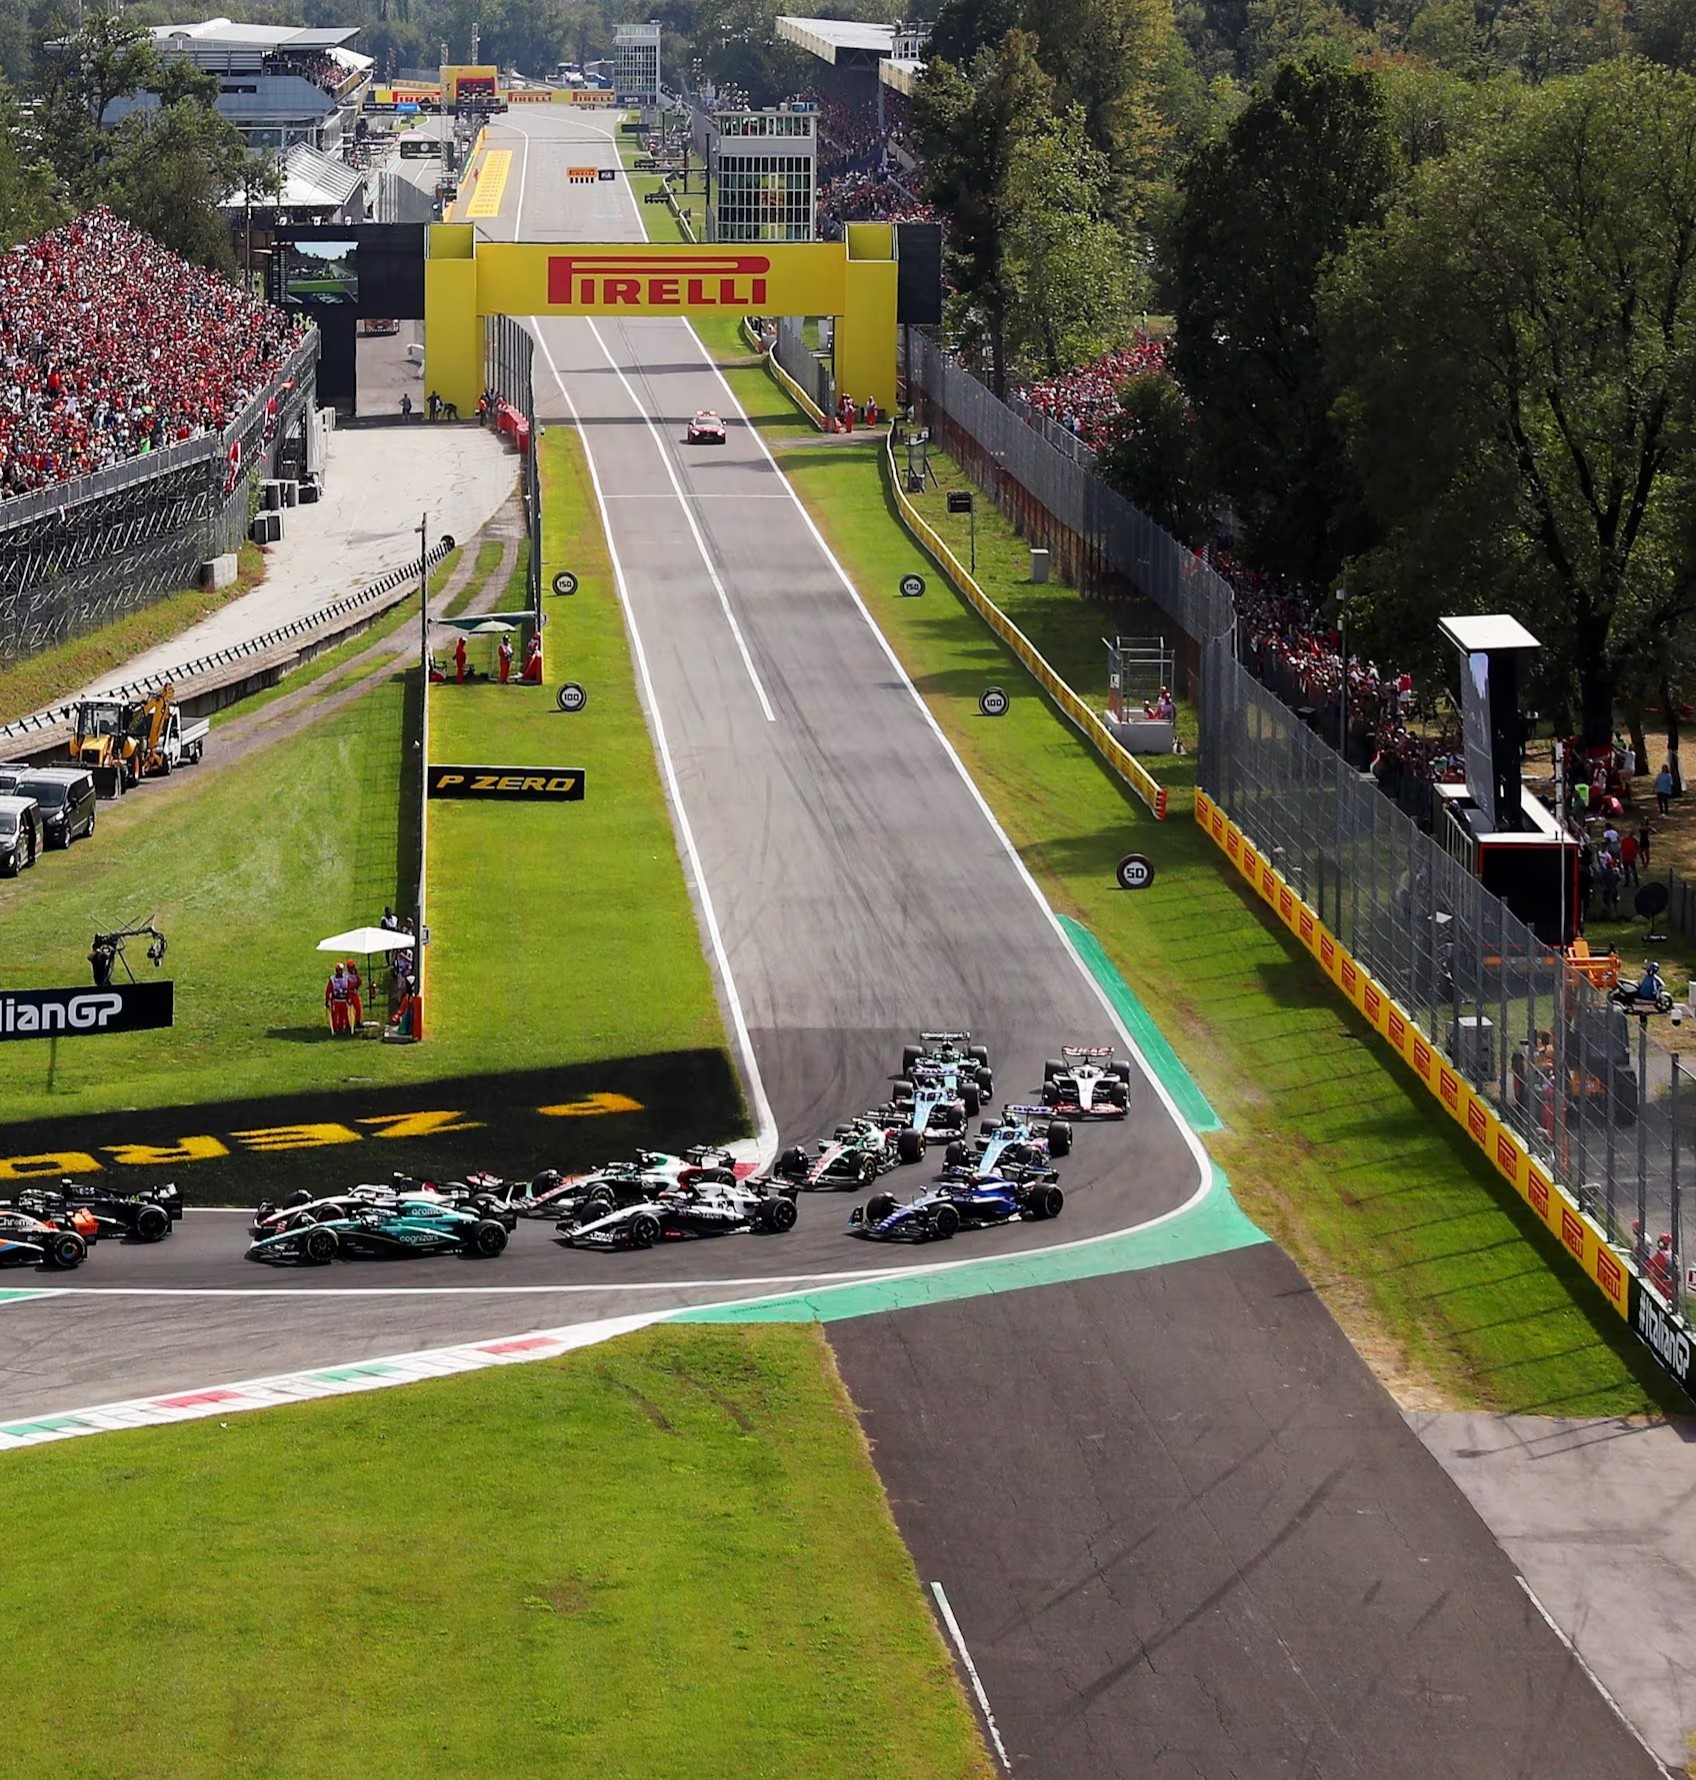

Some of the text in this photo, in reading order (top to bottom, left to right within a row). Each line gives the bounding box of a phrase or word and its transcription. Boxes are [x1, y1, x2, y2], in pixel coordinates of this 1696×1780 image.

[548, 256, 770, 305] PIRELLI
[437, 775, 575, 791] P ZERO
[1127, 868, 1144, 878] 50
[1498, 1133, 1516, 1181] PIRELLI
[1528, 1168, 1548, 1219] PIRELLI
[1562, 1206, 1583, 1260] PIRELLI
[1597, 1247, 1621, 1302] PIRELLI
[1639, 1290, 1691, 1380] #ItalianGP
